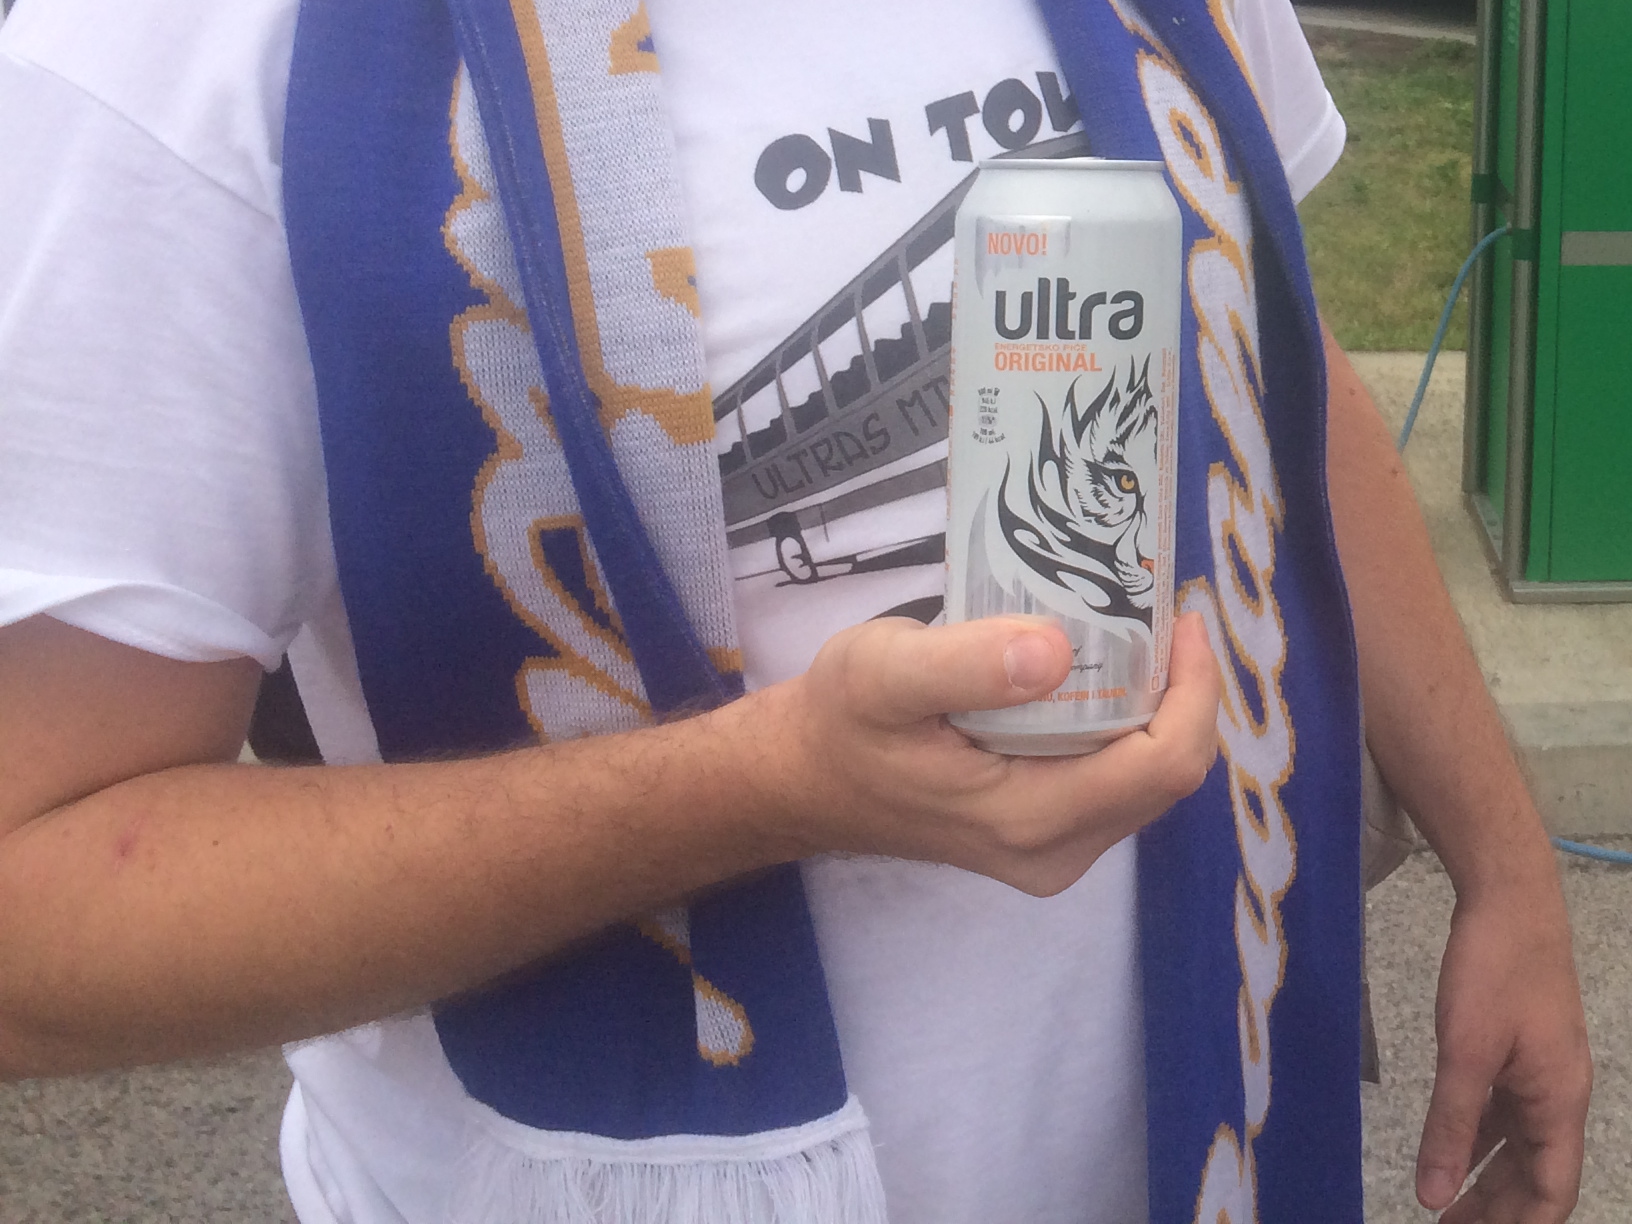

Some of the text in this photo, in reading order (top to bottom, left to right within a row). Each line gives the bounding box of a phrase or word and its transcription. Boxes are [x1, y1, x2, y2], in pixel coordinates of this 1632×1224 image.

[754, 117, 902, 211] ON
[987, 232, 1048, 256] NOVO!
[995, 277, 1144, 341] ultra
[994, 351, 1103, 372] ORIGINAL
[751, 411, 892, 500] ULTRAS
